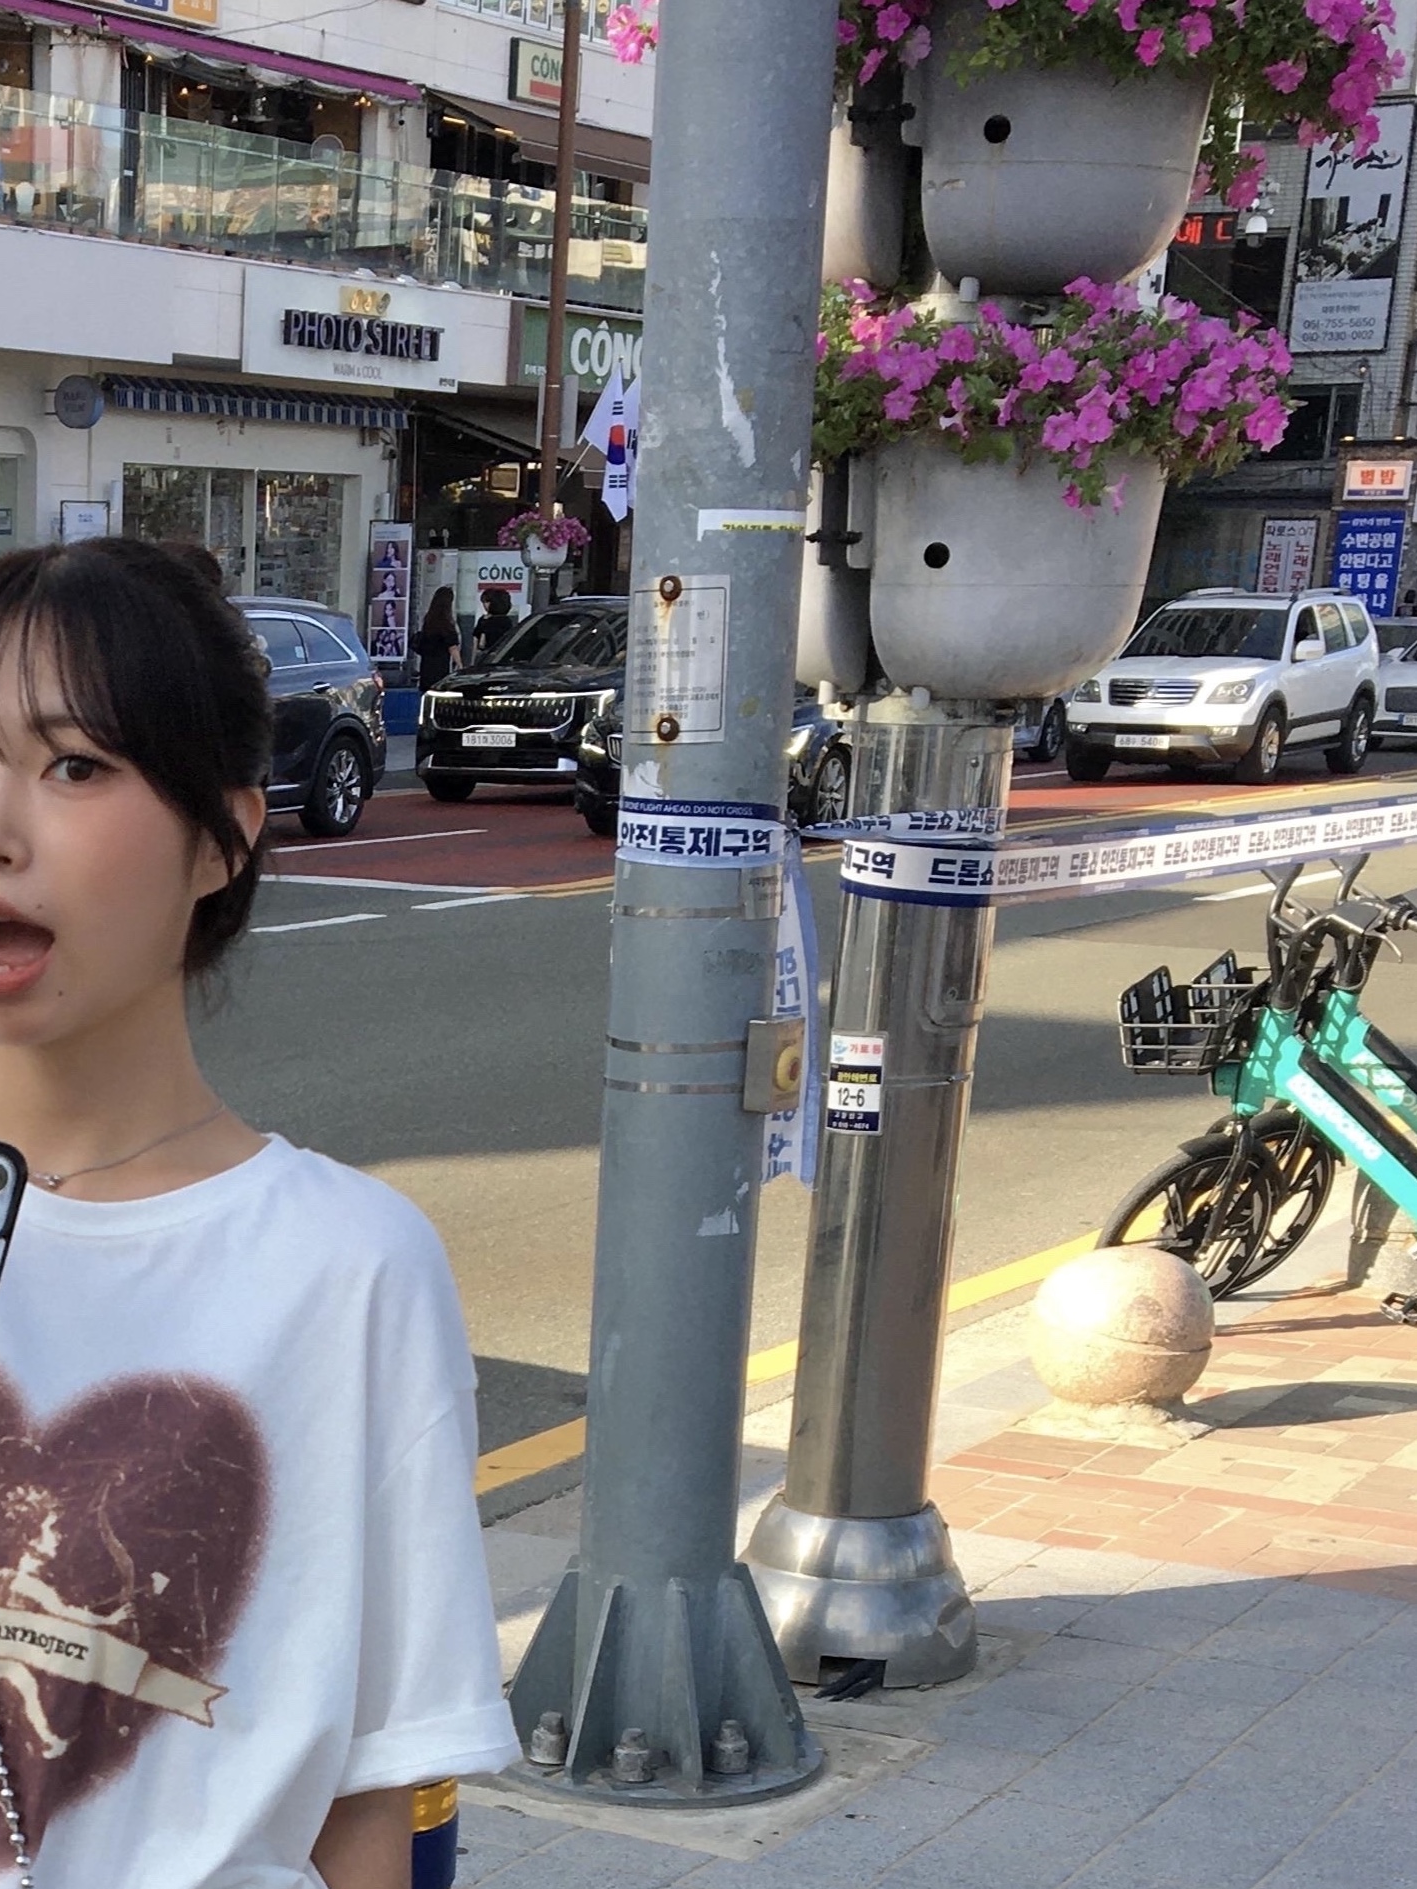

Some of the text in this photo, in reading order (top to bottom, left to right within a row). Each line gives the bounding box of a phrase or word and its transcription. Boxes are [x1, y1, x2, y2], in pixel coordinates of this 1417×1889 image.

[531, 53, 564, 81] CÔN
[284, 309, 445, 362] PHOTO STREET
[1342, 532, 1397, 549] 수변공원
[1339, 553, 1393, 569] 안된다고
[707, 805, 724, 815] NOT
[928, 858, 993, 886] 드론쇼
[997, 854, 1060, 886] 안전통제구역
[1069, 850, 1098, 878] 드론쇼
[1100, 845, 1156, 875] 안전통제구역
[1163, 842, 1190, 866] 드론쇼
[1191, 834, 1241, 862] 안전통제구역
[1248, 831, 1271, 853] 드론쇼
[837, 1087, 865, 1107] 12-6
